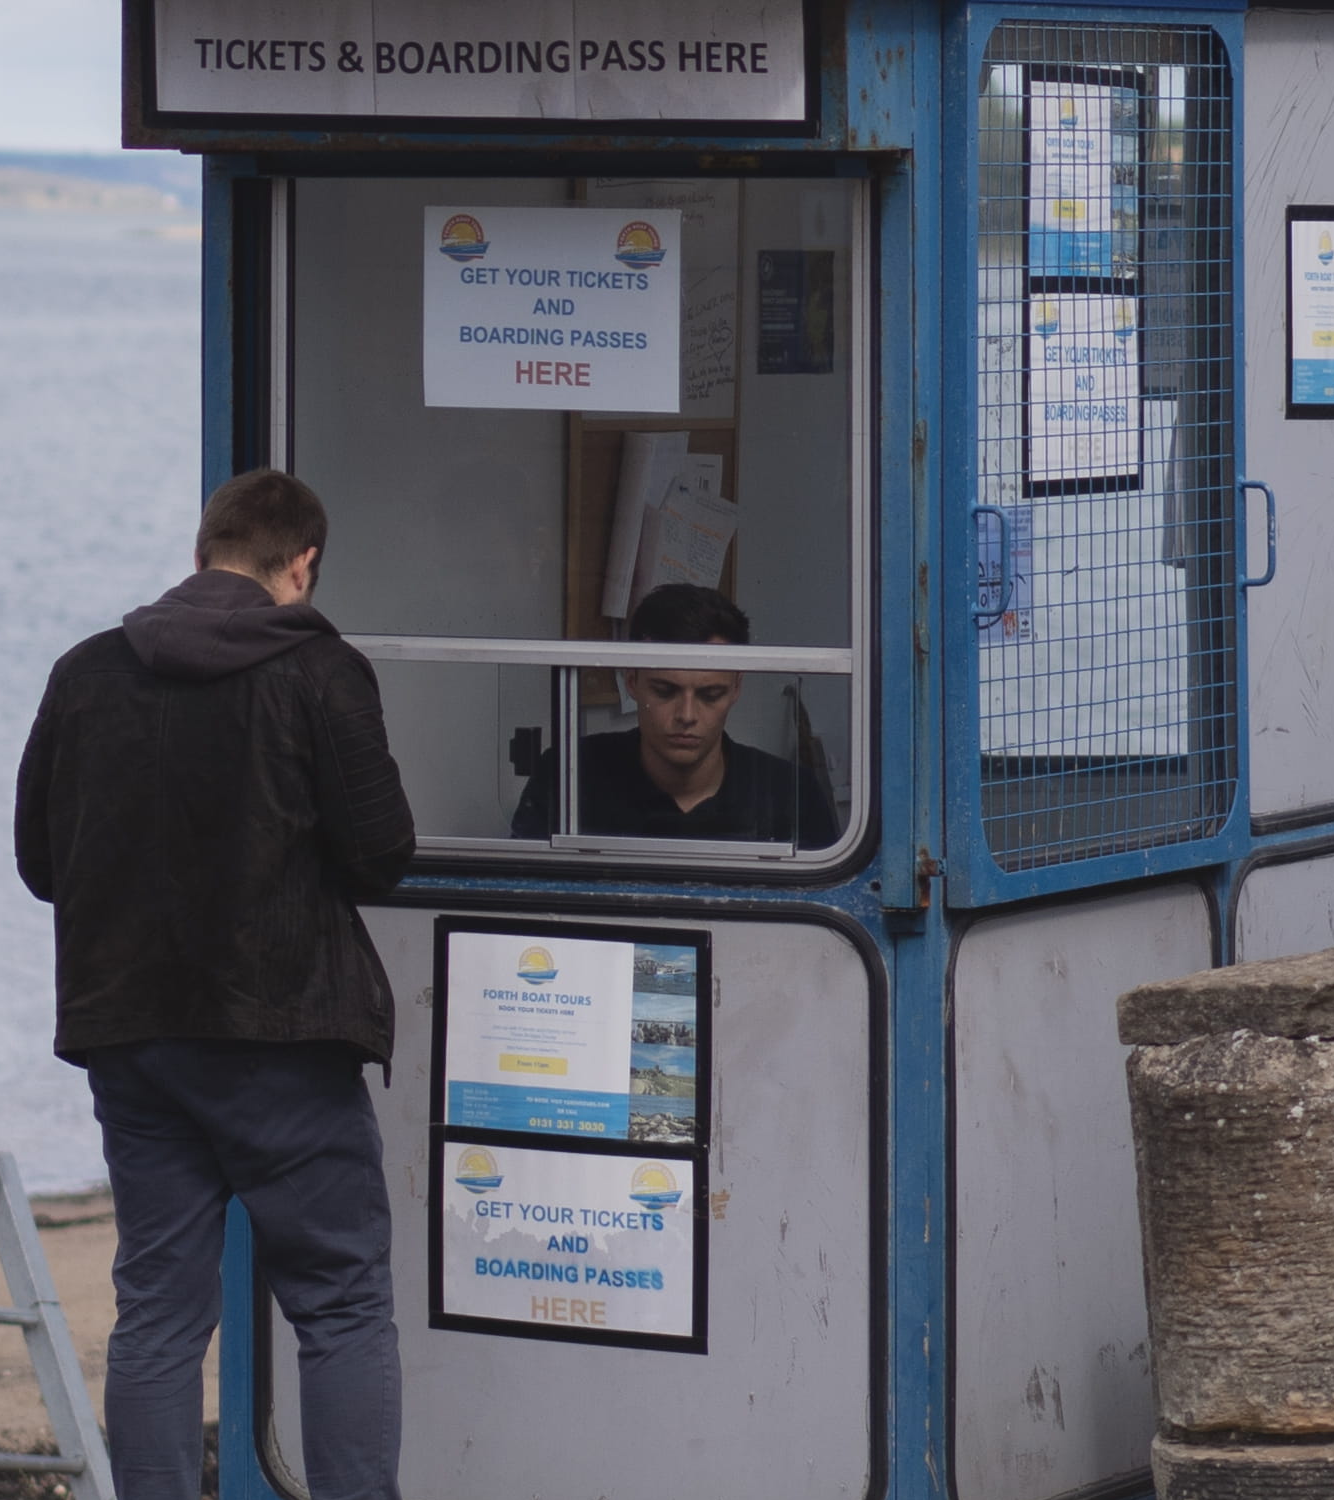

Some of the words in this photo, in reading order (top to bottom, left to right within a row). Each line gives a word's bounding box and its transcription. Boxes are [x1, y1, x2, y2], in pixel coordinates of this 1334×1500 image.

[195, 38, 326, 72] TICKETS
[337, 40, 364, 73] &
[375, 40, 570, 74] BOARDING
[580, 39, 665, 72] PASS
[678, 40, 768, 73] HERE
[460, 266, 499, 285] GET
[505, 268, 560, 287] YOUR
[566, 270, 649, 291] TICKETS
[533, 298, 575, 316] AND
[459, 325, 564, 347] BOARDING
[570, 329, 647, 349] PASSES
[515, 360, 591, 387] HERE
[1075, 375, 1095, 391] AND
[483, 988, 518, 1001] FORTH
[521, 991, 551, 1004] BOAT
[554, 993, 592, 1006] TOURS
[529, 1117, 553, 1129] 0131
[556, 1119, 574, 1130] 331
[475, 1199, 513, 1219] GET
[518, 1203, 574, 1224] YOUR
[579, 1207, 664, 1231] TICKETS
[547, 1235, 589, 1254] AND
[475, 1257, 579, 1283] BOARDING
[584, 1266, 664, 1291] PASSES
[530, 1295, 607, 1326] HERE
